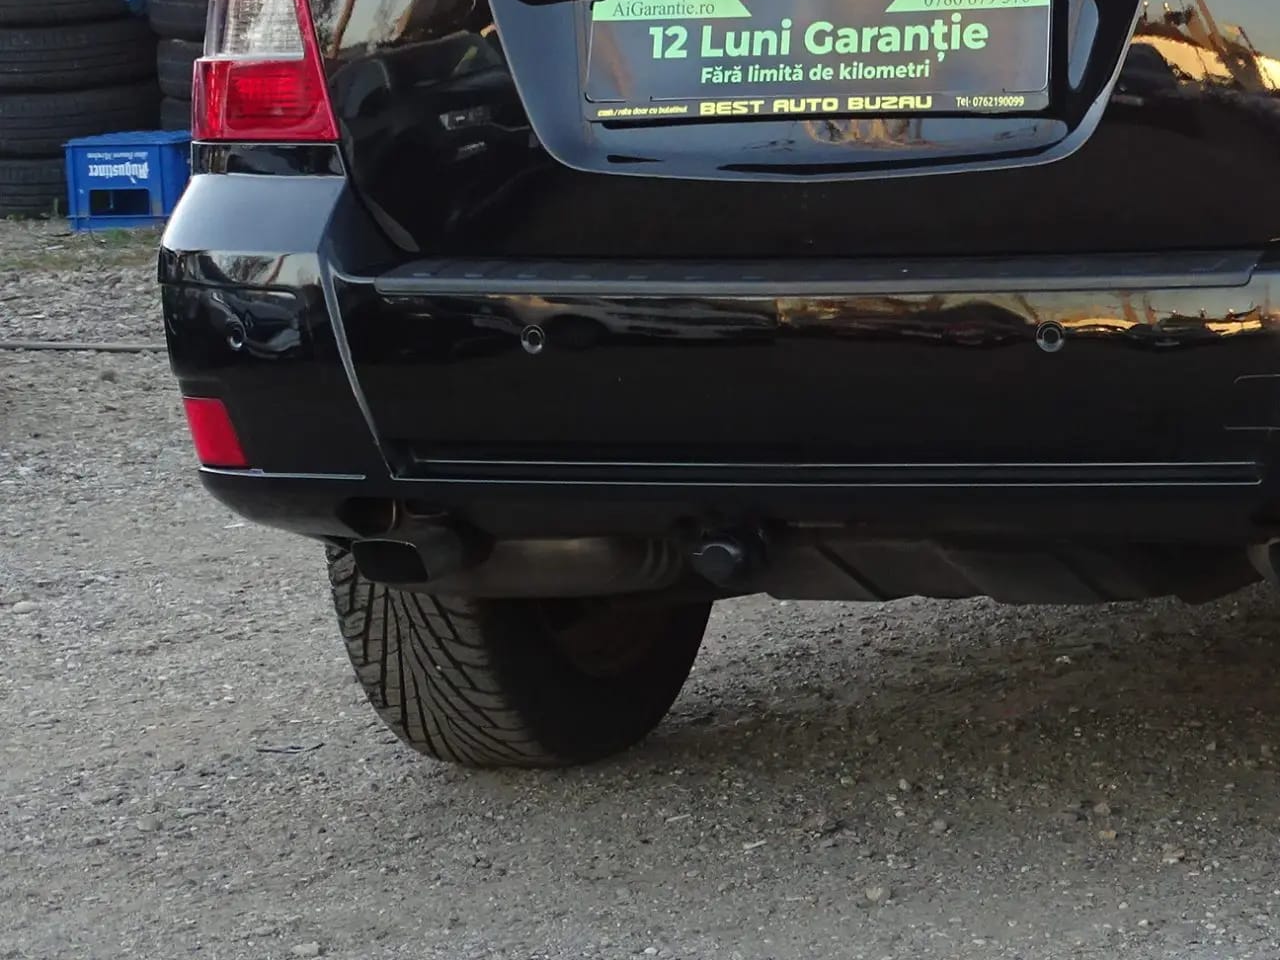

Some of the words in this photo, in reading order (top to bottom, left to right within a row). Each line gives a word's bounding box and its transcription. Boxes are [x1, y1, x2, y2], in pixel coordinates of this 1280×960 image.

[612, 0, 716, 17] AiGarantie.ro
[649, 25, 688, 59] 12
[701, 18, 793, 58] Luni
[804, 12, 989, 62] Garanție
[701, 65, 742, 84] Fără
[748, 62, 804, 82] limită
[809, 63, 834, 81] de
[839, 60, 931, 81] kilometri
[700, 100, 765, 116] BEST
[773, 97, 839, 113] AUTO
[847, 95, 933, 111] BUZAU
